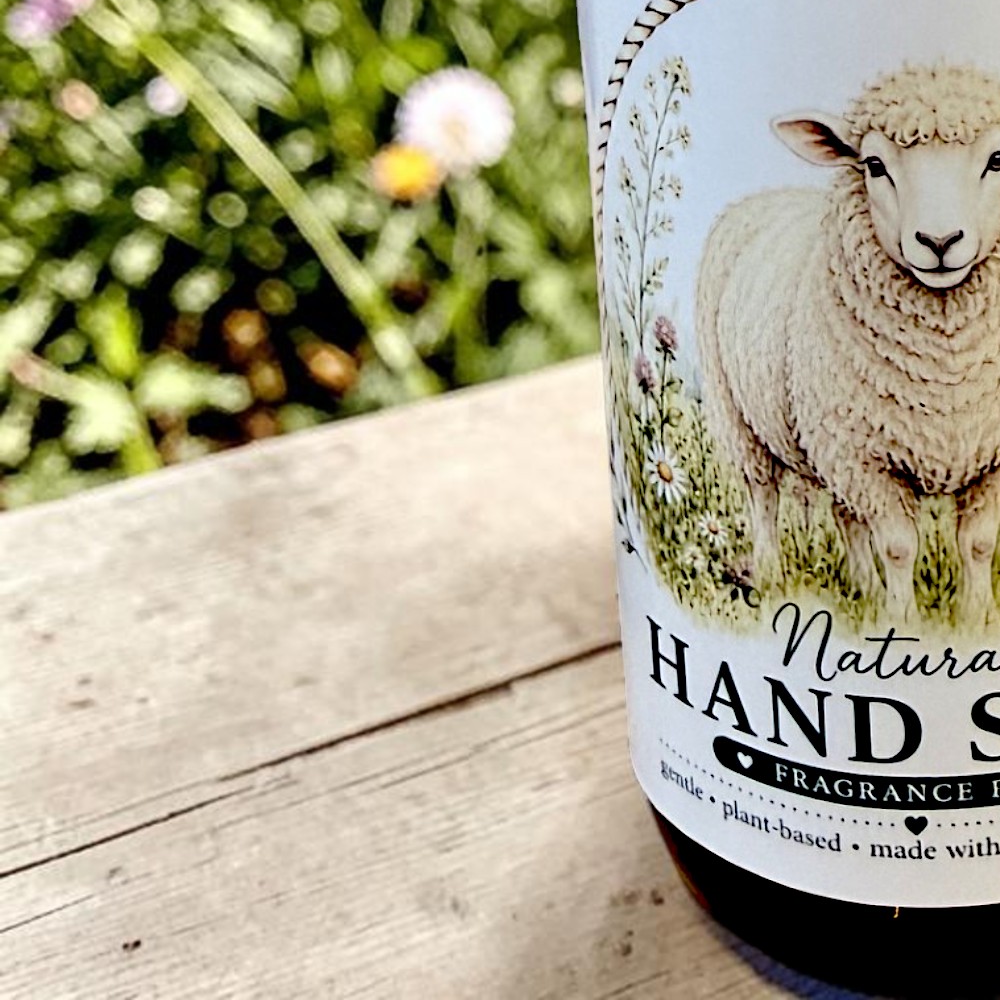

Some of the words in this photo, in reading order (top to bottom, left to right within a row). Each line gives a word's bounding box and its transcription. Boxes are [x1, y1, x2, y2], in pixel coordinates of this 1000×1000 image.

[646, 615, 923, 765] HAND
[660, 759, 704, 801] gentle
[722, 799, 842, 853] plant-based
[869, 840, 937, 861] made
[945, 835, 1000, 860] with
[774, 762, 974, 803] FRAGRANCE
